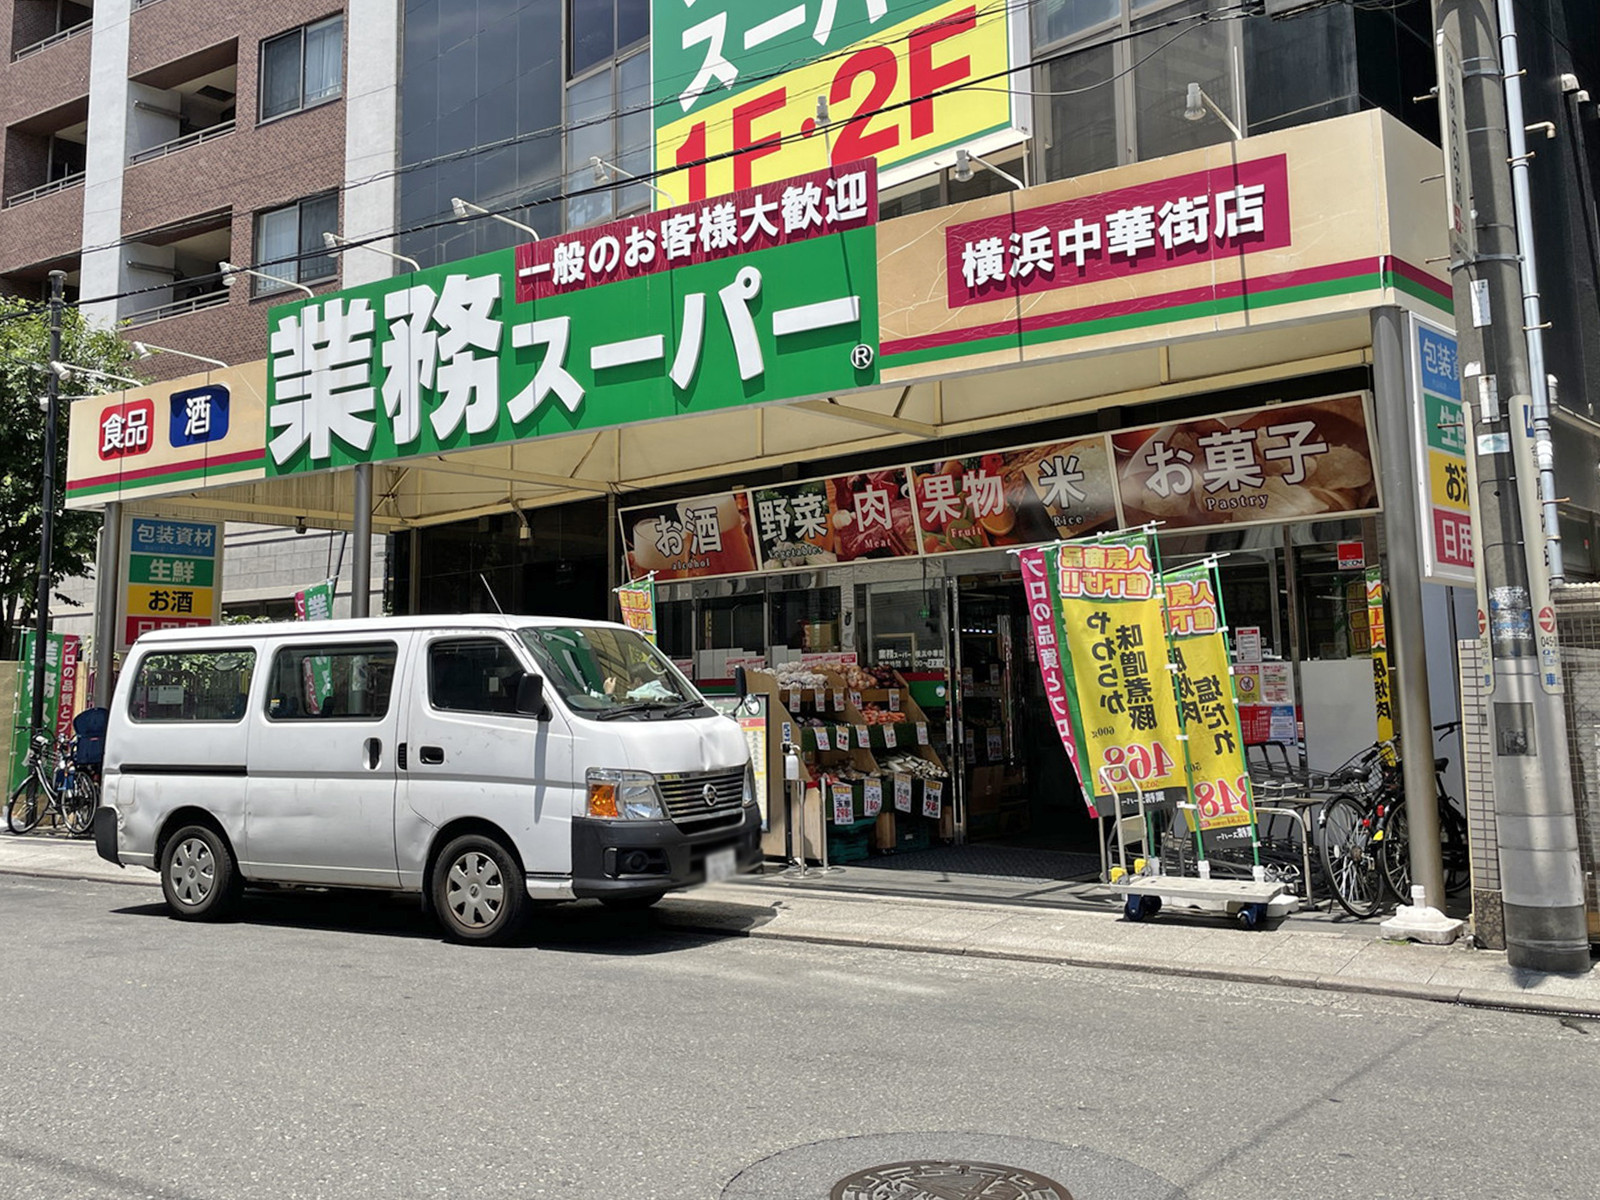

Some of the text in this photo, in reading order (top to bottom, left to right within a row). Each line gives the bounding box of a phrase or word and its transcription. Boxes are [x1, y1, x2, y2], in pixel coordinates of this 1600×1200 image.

[519, 171, 868, 285] 一般のお客様大歓迎
[962, 184, 1265, 288] 横浜中華街店
[268, 266, 861, 465] 業務スーパー
[101, 410, 149, 453] 食品
[184, 394, 211, 437] 酒
[1145, 420, 1328, 499] お菓子
[922, 470, 1003, 524] 果物
[1038, 455, 1087, 510] 米
[1206, 492, 1270, 512] Pastry
[757, 493, 828, 542] 野菜
[853, 484, 894, 532] 肉
[1053, 512, 1083, 527] Rice
[136, 523, 213, 548] 包装資材
[655, 505, 723, 558] お酒
[864, 537, 892, 549] Meat
[950, 525, 982, 540] Fruit
[148, 558, 195, 583] 生鮮
[671, 557, 711, 571] alcohol
[148, 590, 194, 613] お酒
